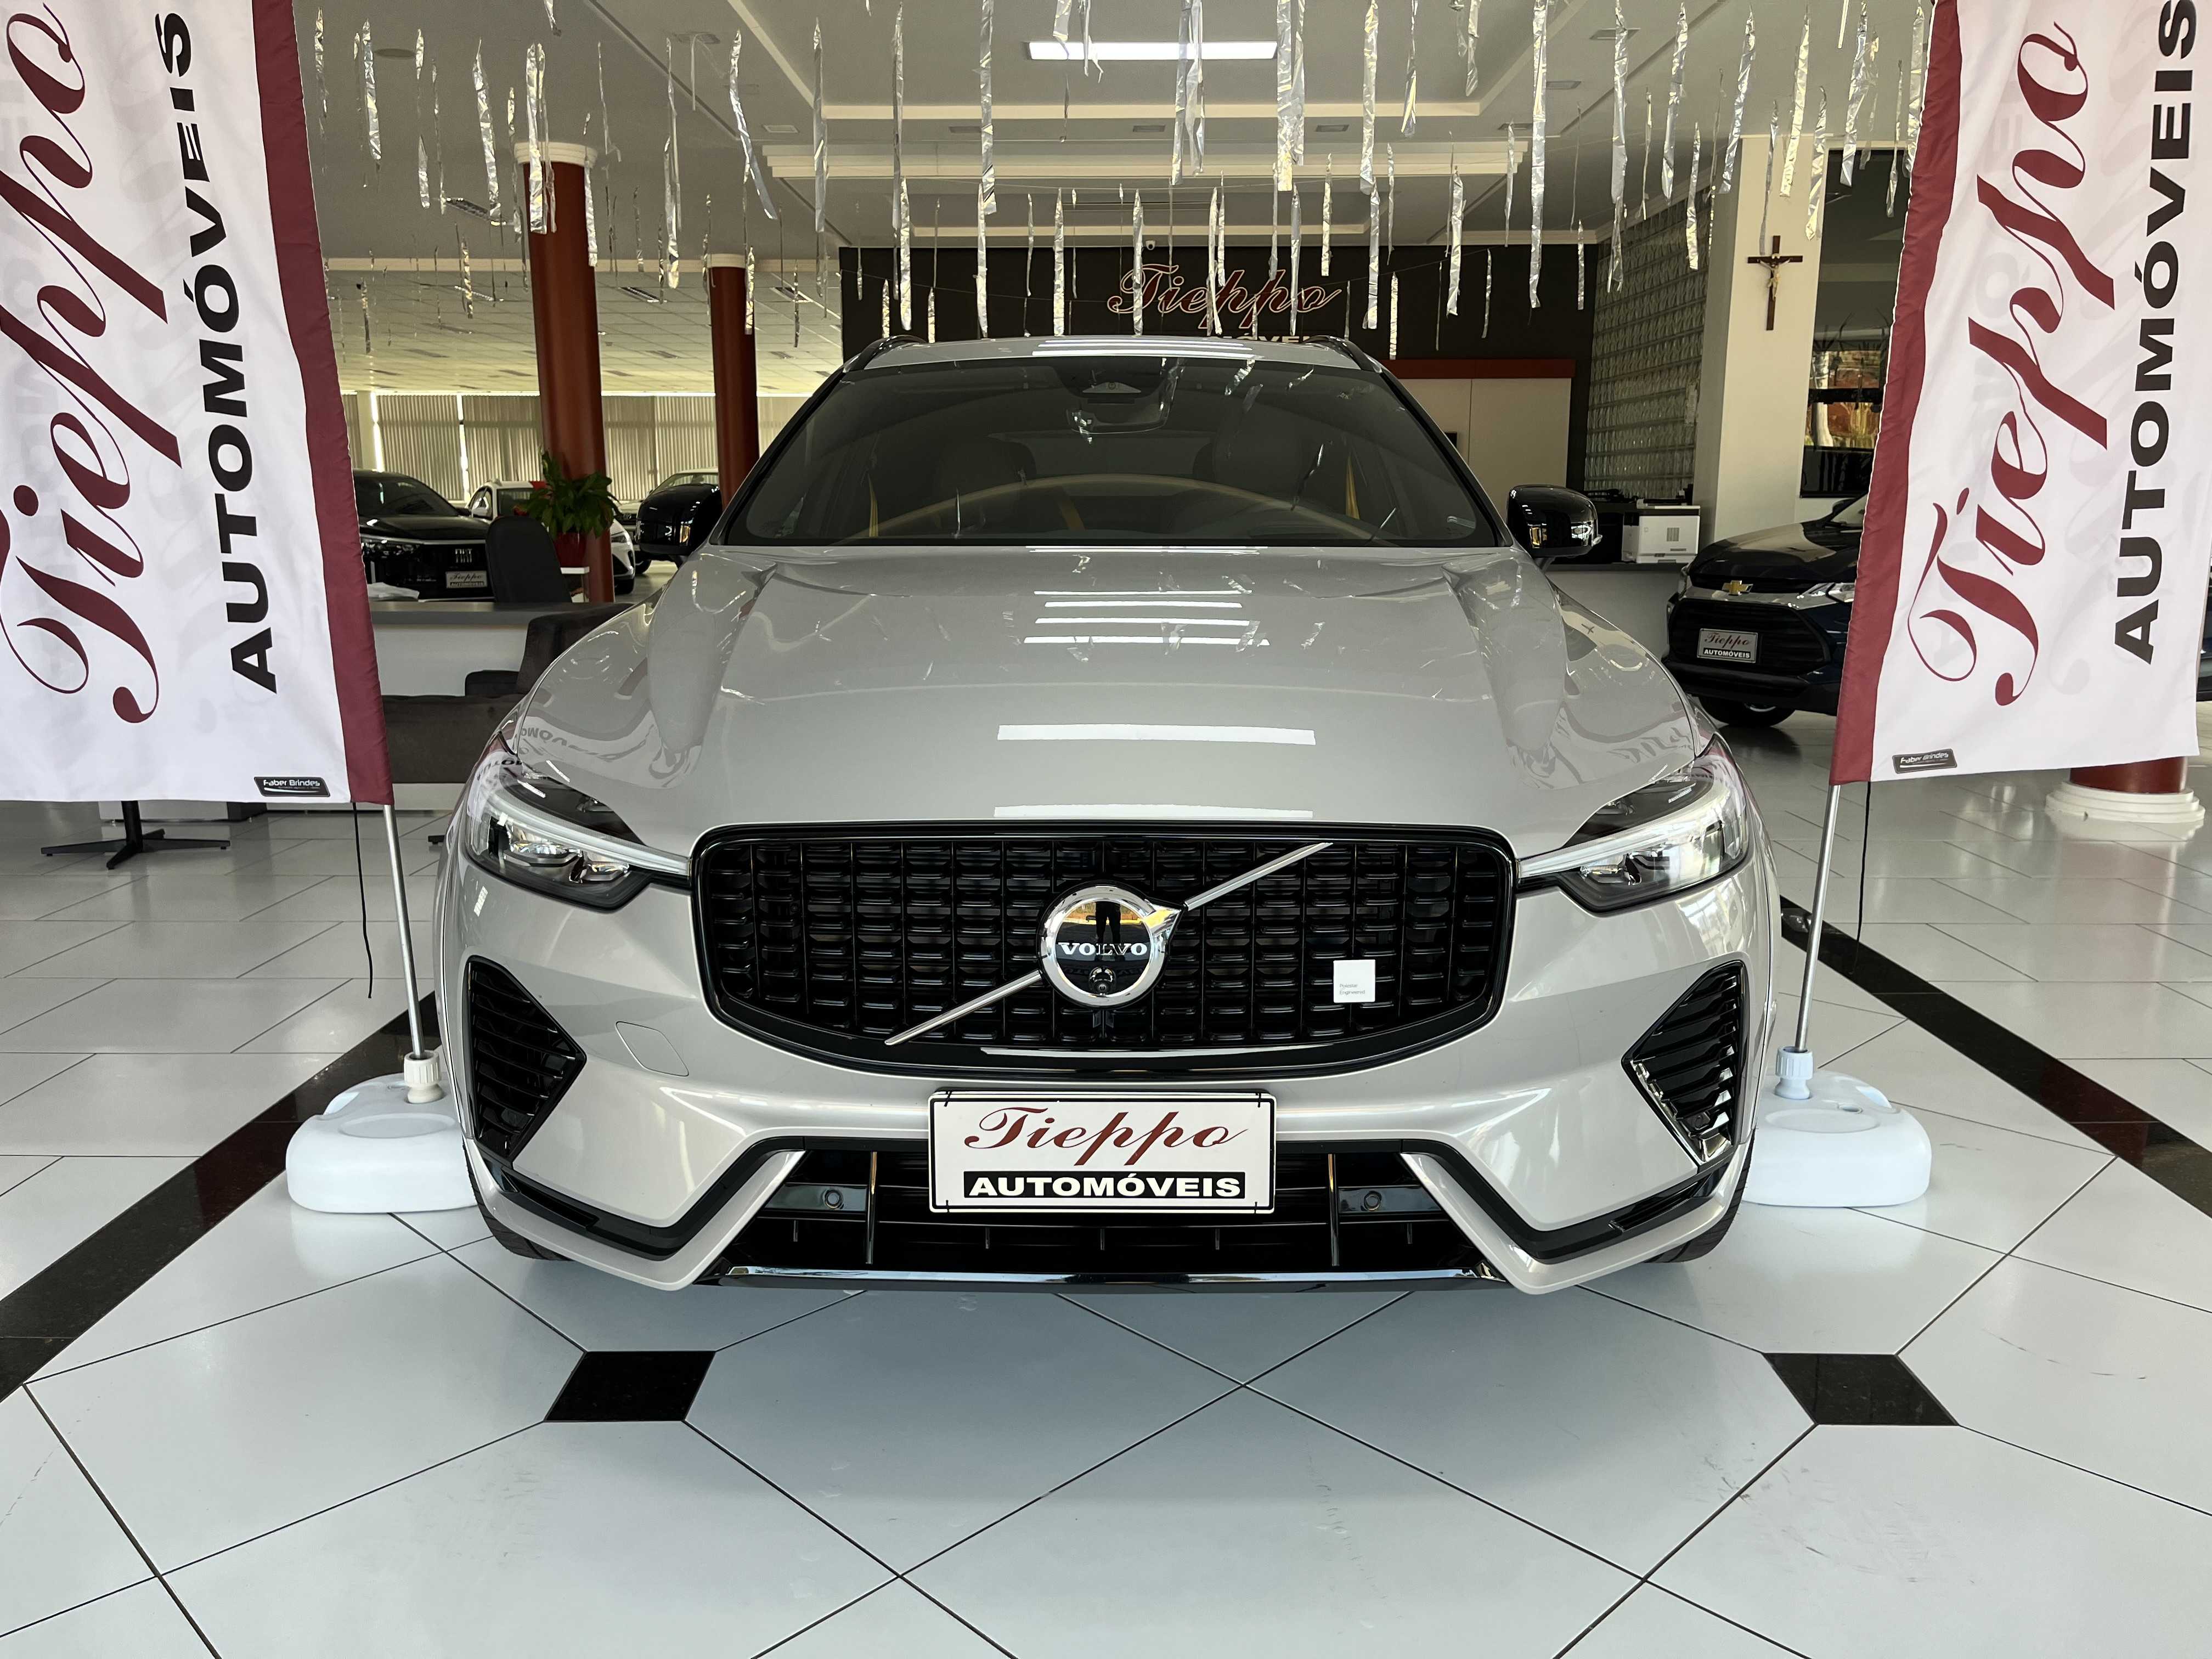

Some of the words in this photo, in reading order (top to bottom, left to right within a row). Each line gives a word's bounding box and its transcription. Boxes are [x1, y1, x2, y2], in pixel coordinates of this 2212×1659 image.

[1107, 263, 1342, 330] Tieppo
[0, 3, 182, 724] Tieppo
[155, 13, 277, 694] AUTOMÓVEIS
[1908, 21, 2115, 706] Tieppo
[2114, 0, 2197, 665] AUTOMÓVEIS
[1704, 632, 1751, 648] Tieppo
[1704, 649, 1750, 658] AUTOMÓVEIS
[1058, 942, 1148, 956] VOLVO
[963, 1107, 1249, 1166] Tieppo
[969, 1173, 1241, 1198] AUTOMÓVEIS
